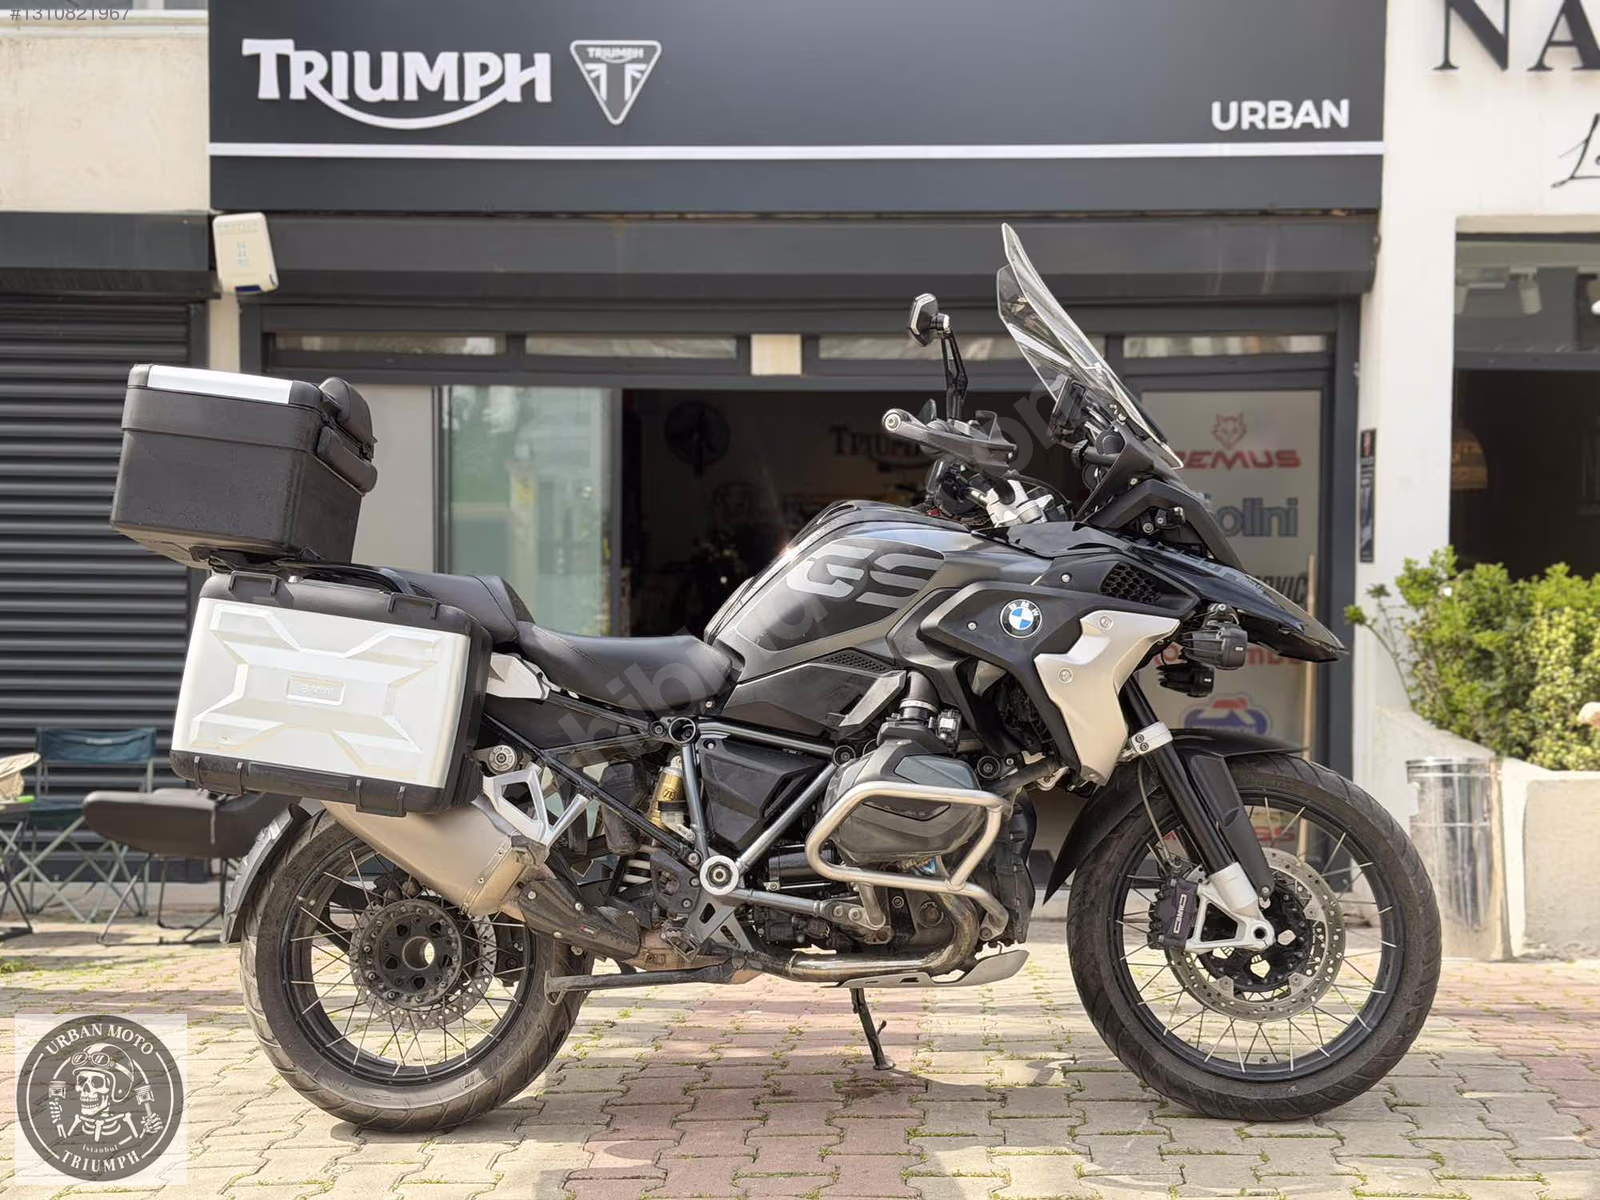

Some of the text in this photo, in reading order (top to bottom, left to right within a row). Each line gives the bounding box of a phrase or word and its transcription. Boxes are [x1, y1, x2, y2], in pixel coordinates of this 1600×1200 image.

[586, 46, 645, 64] TRIUMPH
[242, 38, 552, 130] TRIUMPH
[1211, 98, 1350, 132] URBAN
[785, 543, 946, 610] GS
[1008, 600, 1040, 617] BMW
